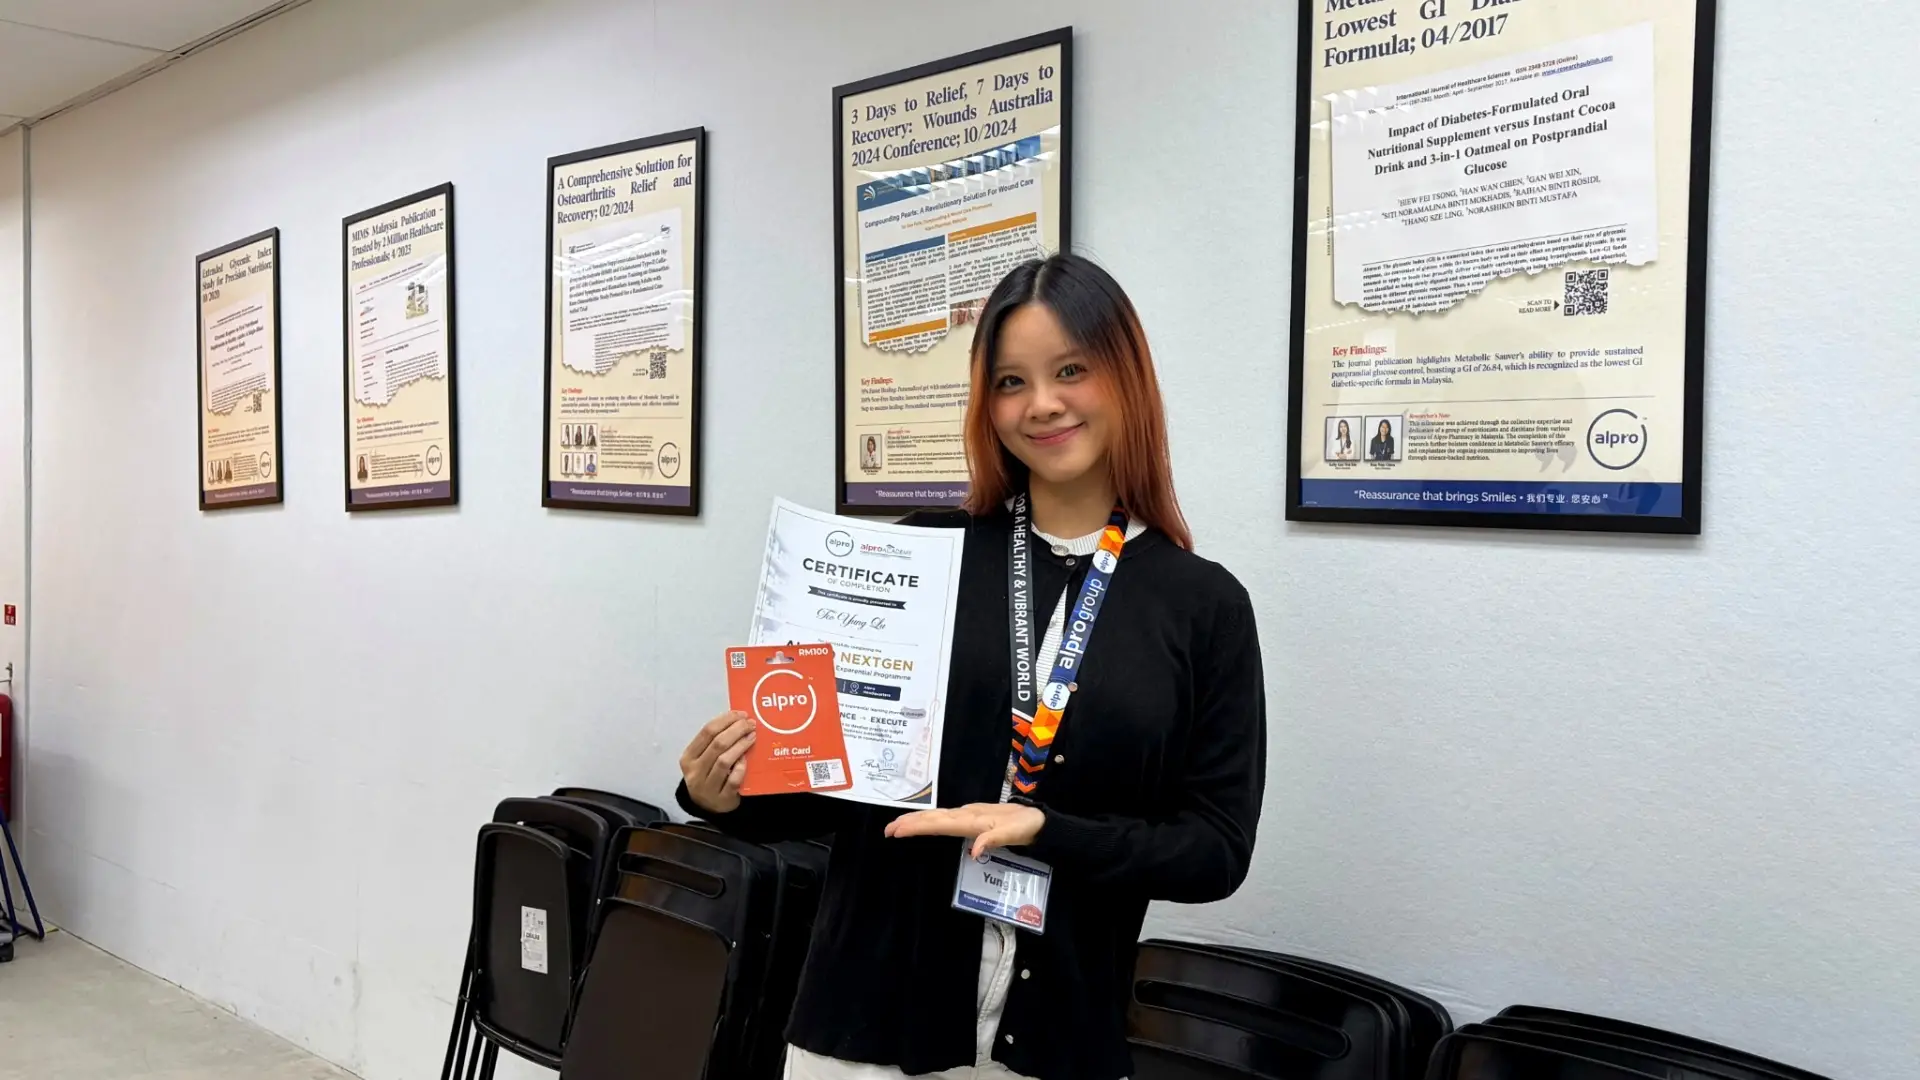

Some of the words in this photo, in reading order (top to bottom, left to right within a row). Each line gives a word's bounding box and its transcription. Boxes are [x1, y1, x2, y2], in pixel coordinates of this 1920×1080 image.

[1325, 9, 1397, 40] Lowest
[1419, 0, 1447, 19] GI
[1324, 34, 1415, 67] Formula;
[1421, 13, 1509, 49] 04/2017
[1457, 76, 1487, 87] Healthcare
[851, 109, 859, 124] 3
[866, 102, 896, 122] Days
[904, 97, 917, 112] to
[926, 83, 968, 107] Relief,
[977, 79, 984, 95] 7
[994, 70, 1029, 92] Days
[1038, 65, 1053, 80] to
[851, 122, 913, 146] Recovery:
[923, 105, 977, 130] Wounds
[988, 89, 1053, 116] Australia
[1388, 122, 1425, 138] Impact
[1427, 117, 1439, 129] of
[1441, 92, 1558, 126] Diabetes-Formulated
[1562, 85, 1590, 101] Oral
[1368, 138, 1424, 159] Nutritional
[1426, 126, 1491, 148] Supplement
[1494, 119, 1530, 133] versus
[1532, 107, 1575, 125] Instant
[1578, 101, 1616, 116] Cocoa
[852, 147, 880, 166] 2024
[883, 133, 960, 160] Conference;
[964, 117, 1017, 145] 10/2024
[1374, 160, 1405, 175] Drink
[1407, 156, 1427, 168] and
[1430, 149, 1460, 164] 3-in-1
[1464, 139, 1511, 157] Oatmeal
[1514, 138, 1528, 148] on
[1532, 119, 1608, 144] Postprandial
[557, 178, 564, 190] A
[567, 166, 633, 189] Comprehensive
[635, 155, 674, 175] Solution
[677, 154, 692, 168] for
[1464, 160, 1507, 175] Glucose
[557, 185, 616, 206] Osteoarthritis
[631, 177, 658, 194] Relief
[673, 171, 692, 187] and
[1480, 182, 1499, 192] WAN
[1548, 170, 1564, 180] WEI
[1448, 198, 1468, 208] BINTI
[1548, 180, 1570, 191] BINTI
[1516, 197, 1537, 207] BINTI
[1539, 190, 1578, 204] MUSTAFA
[372, 220, 398, 236] Malaysia
[400, 207, 436, 227] Publication
[557, 207, 598, 224] Recovery;
[599, 200, 634, 218] 02/2024
[352, 242, 372, 257] Trusted
[373, 238, 381, 251] by
[387, 231, 408, 246] Million
[409, 221, 444, 239] Healthcare
[257, 247, 272, 260] Index
[1332, 360, 1345, 368] The
[1348, 359, 1371, 369] journal
[1375, 357, 1412, 369] publication
[1416, 355, 1450, 365] highlights
[1455, 353, 1490, 362] Metabolic
[1528, 350, 1554, 360] ability
[1570, 348, 1600, 359] provide
[1605, 346, 1643, 356] sustained
[1333, 346, 1348, 357] Key
[1350, 345, 1387, 357] Findings:
[1372, 368, 1397, 378] glucose
[1426, 366, 1456, 376] boasting
[1473, 364, 1481, 372] of
[1504, 362, 1527, 371] which
[1528, 362, 1535, 370] is
[1536, 360, 1579, 371] recognized
[1604, 358, 1631, 366] lowest
[1632, 357, 1643, 366] GI
[1331, 378, 1384, 389] diabetic-specific
[1385, 377, 1412, 386] formula
[1422, 377, 1454, 386] Malaysia.
[1595, 430, 1639, 448] alpro
[915, 490, 926, 498] that
[927, 490, 947, 499] brings
[1422, 490, 1443, 501] that
[1446, 491, 1479, 504] brings
[1481, 491, 1517, 502] Smiles
[1015, 516, 1026, 524] A
[829, 538, 850, 548] alpro
[1013, 524, 1026, 576] HEALTHY
[1099, 552, 1111, 570] alpro
[802, 557, 919, 588] CERTIFICATE
[827, 577, 838, 585] OF
[840, 580, 891, 593] COMPLETION
[1013, 580, 1027, 588] &
[1014, 590, 1029, 644] VIBRANT
[798, 647, 829, 657] RM100
[840, 652, 913, 671] NEXTGEN
[873, 670, 911, 681] Programme
[1016, 648, 1031, 701] WORLD
[761, 693, 808, 711] alpro
[1050, 684, 1063, 708] alpro
[870, 716, 908, 727] EXECUTE
[773, 747, 790, 756] Gift
[791, 745, 811, 755] Card
